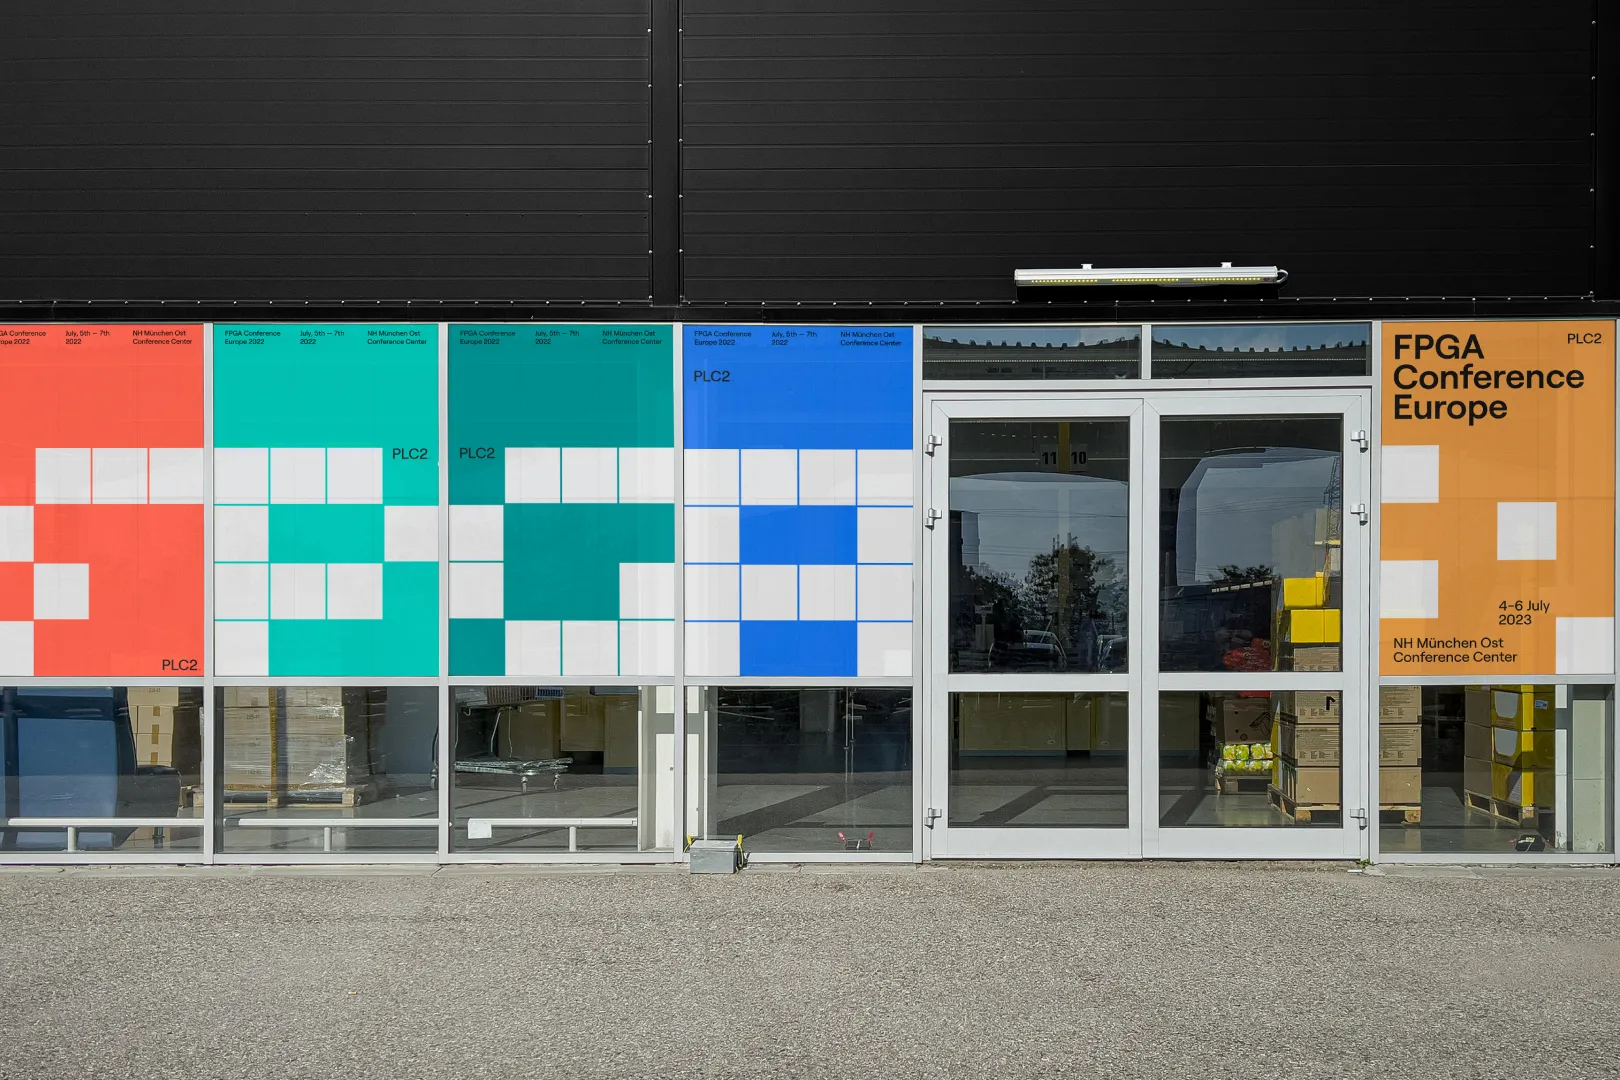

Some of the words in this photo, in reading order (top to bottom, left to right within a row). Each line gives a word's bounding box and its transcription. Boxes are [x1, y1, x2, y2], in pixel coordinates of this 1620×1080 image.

[65, 330, 78, 338] July,
[299, 330, 313, 338] July,
[535, 330, 549, 338] July,
[714, 330, 752, 338] Conference
[771, 331, 785, 339] July,
[1567, 333, 1602, 345] PLC2
[224, 338, 248, 346] Europe
[459, 338, 483, 346] Europe
[694, 339, 718, 347] Europe
[840, 339, 879, 347] Conference
[880, 339, 903, 347] Center
[1395, 334, 1484, 360] FPGA
[694, 370, 731, 383] PLC2
[1394, 363, 1585, 390] Conference
[1394, 394, 1508, 427] Europe
[392, 447, 428, 460] PLC2
[459, 447, 496, 459] PLC2
[1042, 452, 1057, 465] 11
[1071, 452, 1087, 465] 10
[1526, 600, 1551, 614] July
[1498, 614, 1532, 626] 2023
[1393, 637, 1413, 649] NH
[1416, 636, 1477, 649] München
[1480, 636, 1504, 649] Ost
[1393, 651, 1470, 663] Conference
[1473, 651, 1518, 663] Center
[162, 659, 198, 671] PLC2
